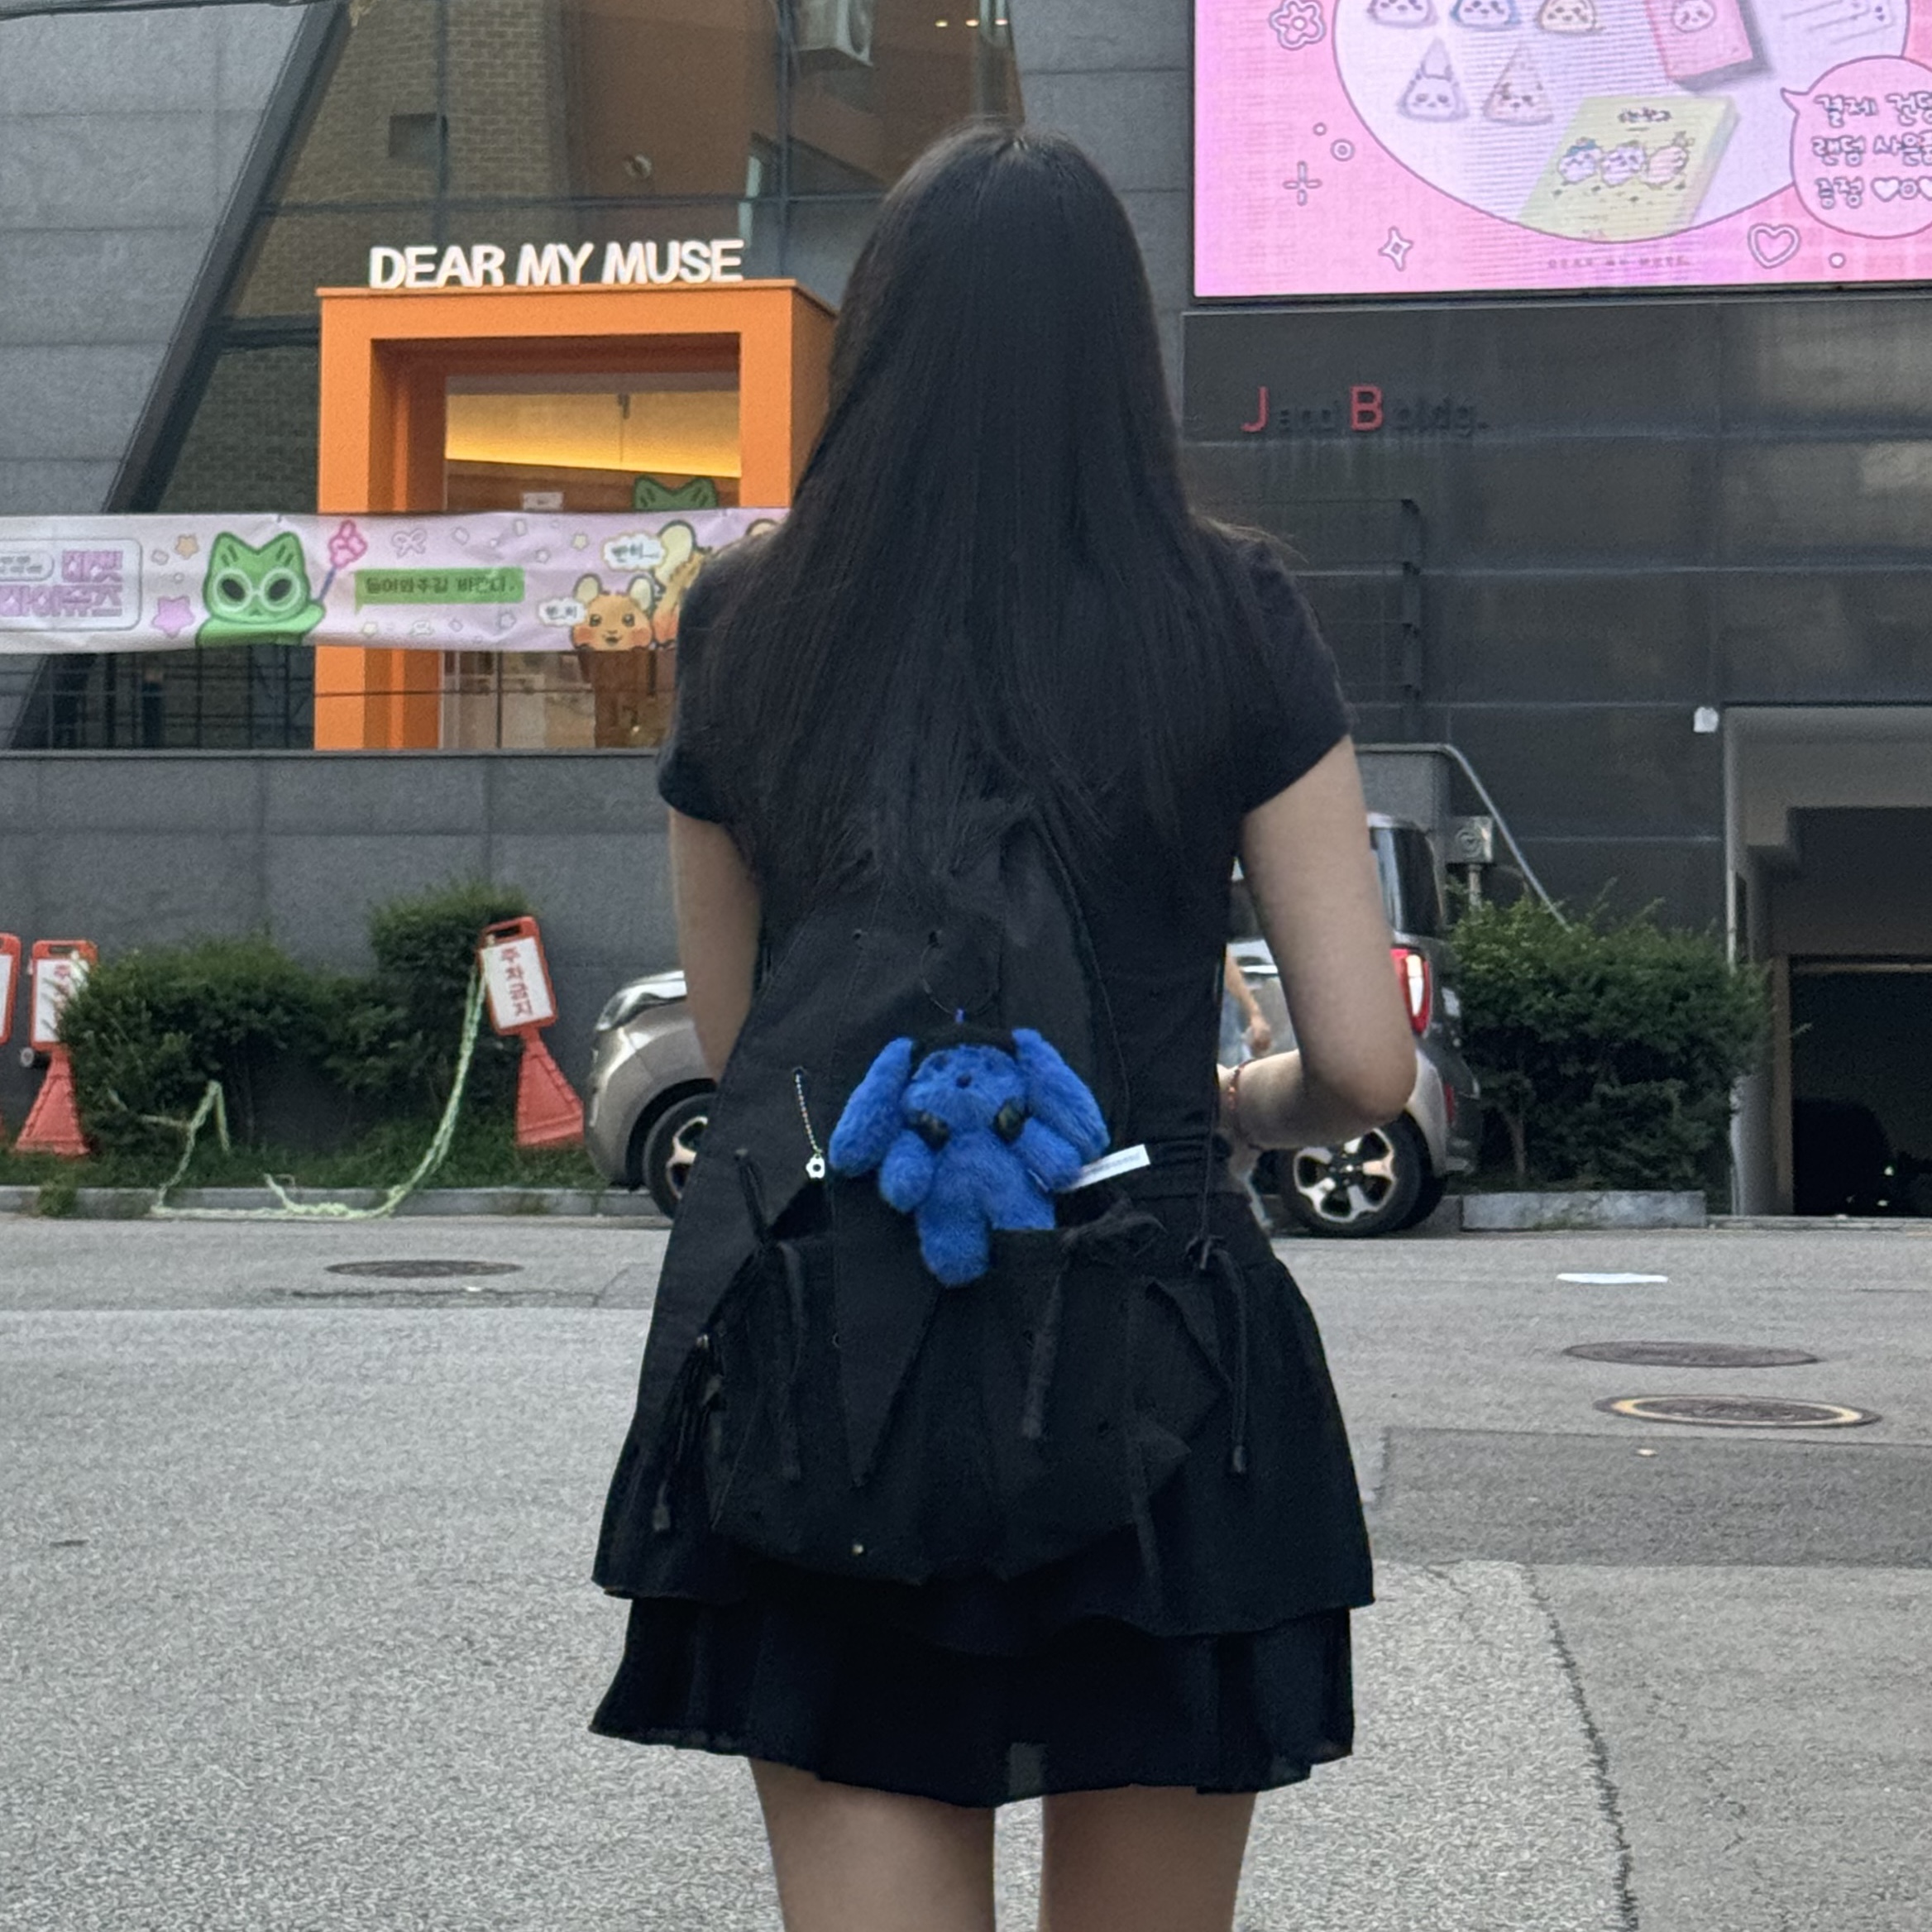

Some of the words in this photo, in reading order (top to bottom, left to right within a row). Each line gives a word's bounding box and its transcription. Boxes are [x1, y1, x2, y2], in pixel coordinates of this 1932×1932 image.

[1813, 93, 1879, 128] 결제
[1810, 134, 1867, 167] 랜덤
[1814, 175, 1865, 210] 증정
[369, 243, 506, 289] DEAR
[515, 242, 595, 286] MY
[601, 239, 744, 285] MUSE
